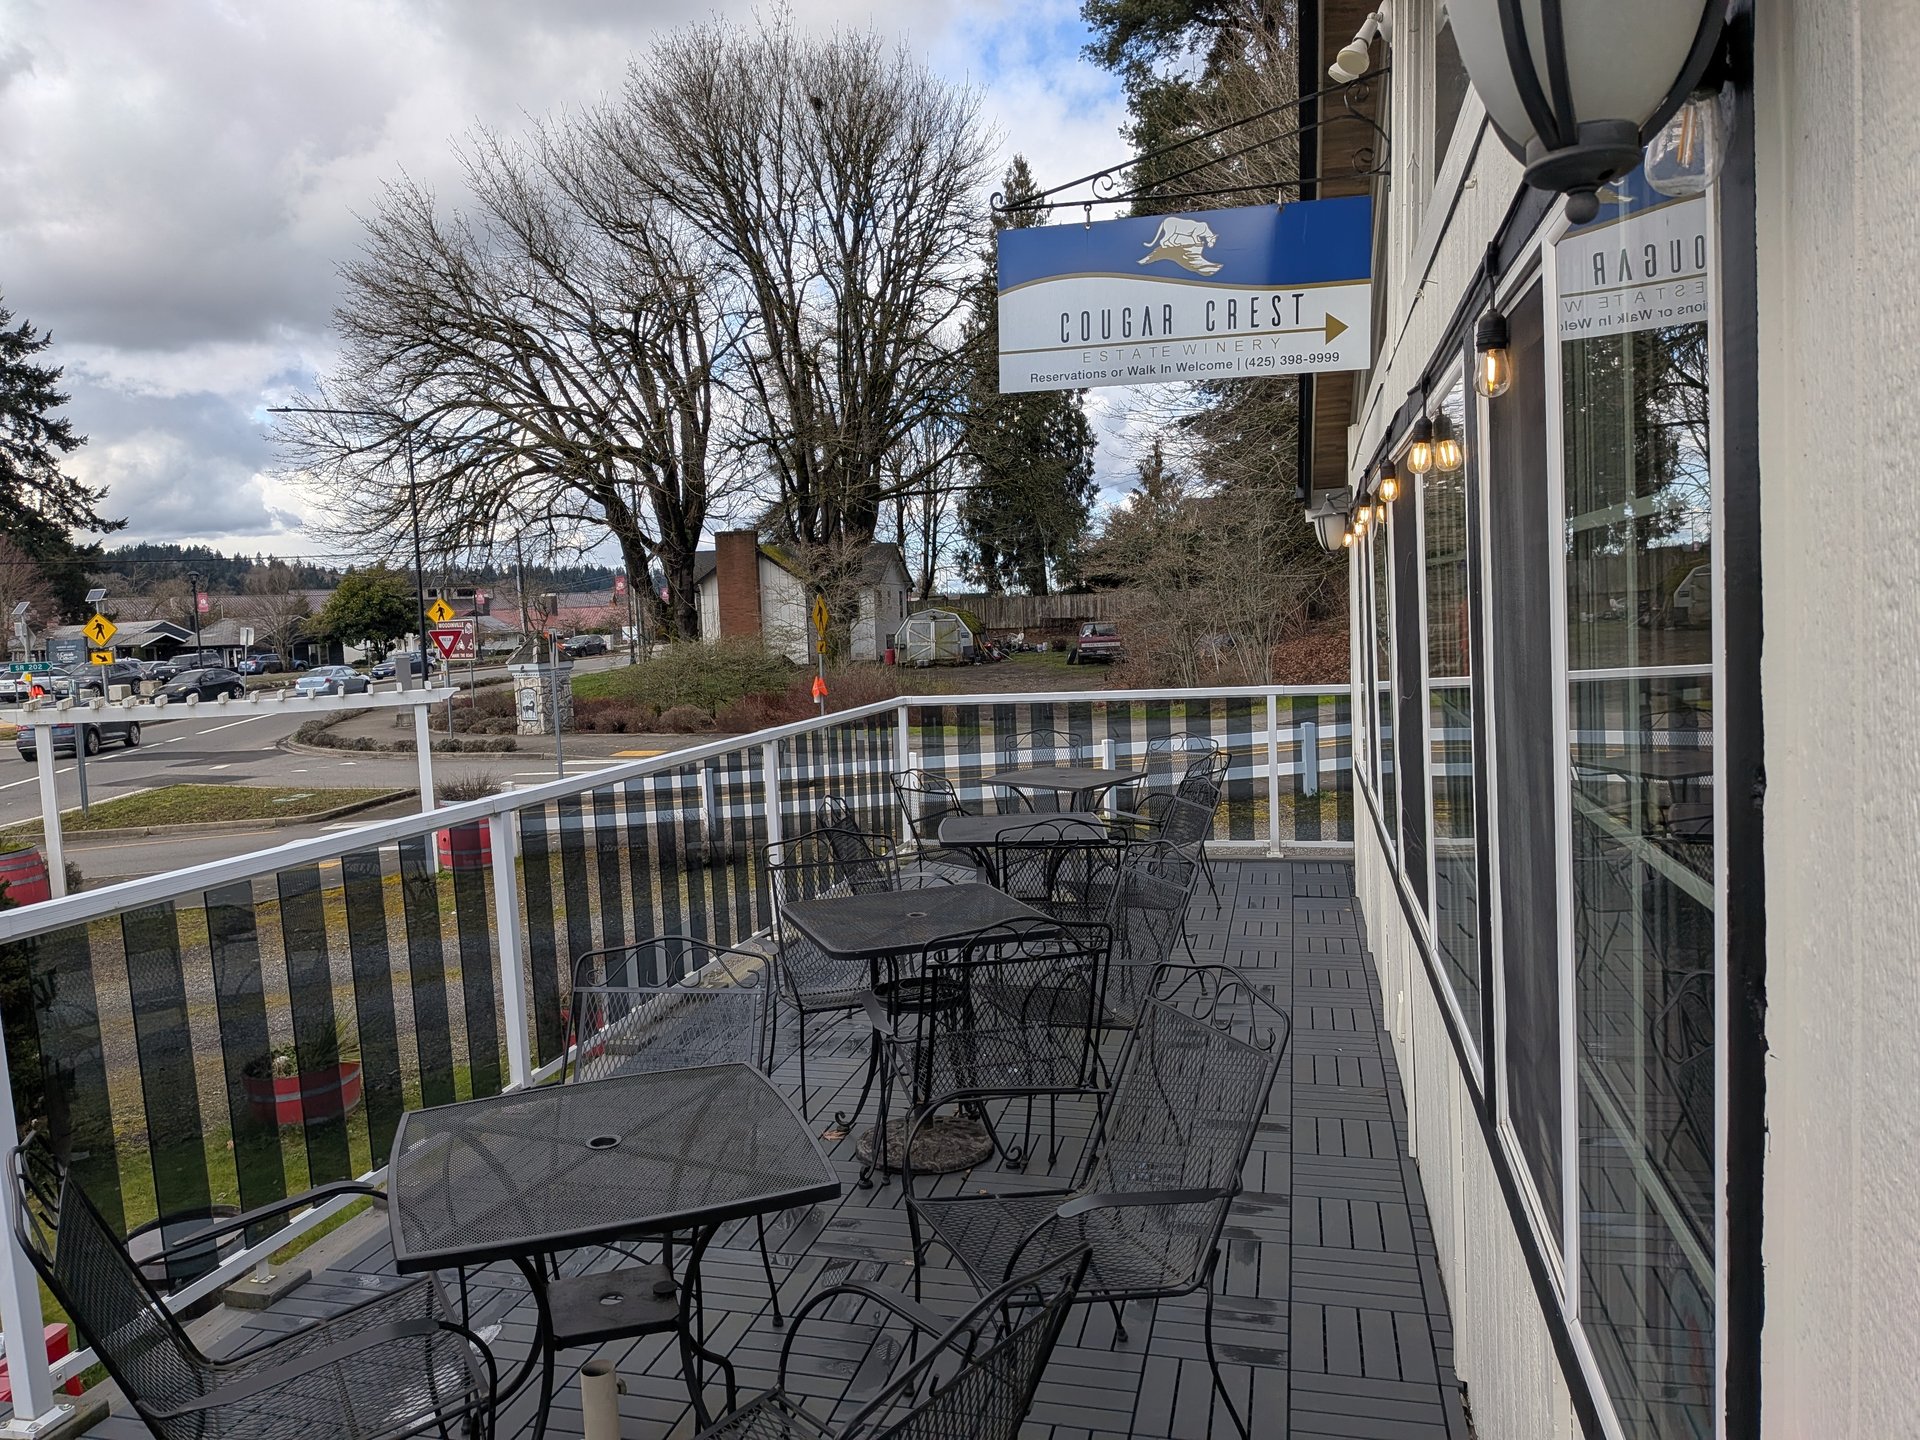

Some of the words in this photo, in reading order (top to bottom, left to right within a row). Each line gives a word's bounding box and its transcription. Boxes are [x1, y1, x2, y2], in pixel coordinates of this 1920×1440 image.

[1060, 303, 1173, 343] COUGAR
[1205, 293, 1305, 332] CREST
[1082, 345, 1171, 364] ESTATE
[1183, 337, 1281, 355] WINERY
[1030, 369, 1107, 383] Reservations
[1110, 367, 1124, 378] or
[1127, 364, 1157, 376] Walk
[1160, 363, 1172, 374] In
[1176, 360, 1233, 373] Welcome
[1244, 355, 1276, 369] (425)
[1279, 352, 1340, 366] 398-9999
